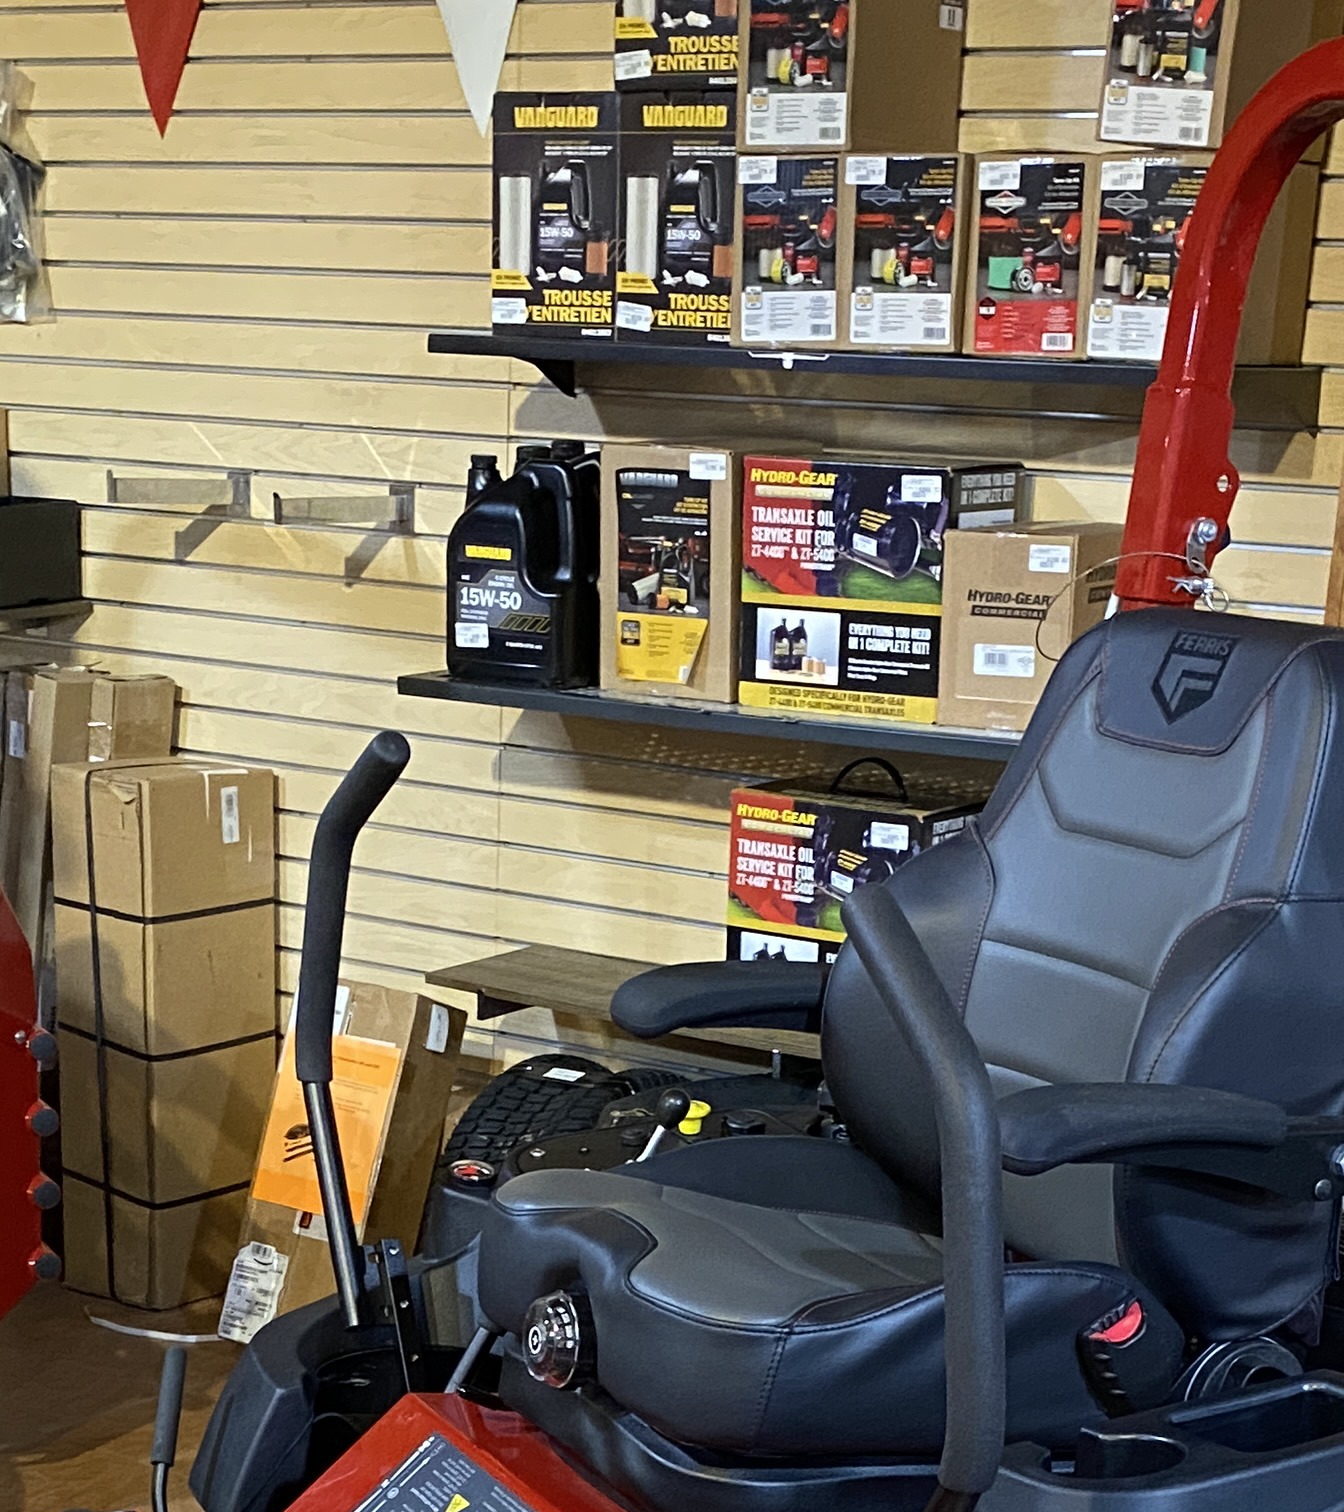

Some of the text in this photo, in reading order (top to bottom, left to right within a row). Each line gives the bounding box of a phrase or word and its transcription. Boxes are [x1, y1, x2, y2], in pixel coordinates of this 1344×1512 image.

[668, 35, 738, 54] TROUSSE
[651, 53, 738, 72] 'ENTRETIEN
[514, 106, 599, 128] VANGUARD
[643, 105, 728, 128] VANGUARD
[540, 226, 574, 238] 15W-50
[667, 229, 701, 241] 15W-50
[543, 289, 612, 306] TROUSSE
[668, 293, 731, 311] TROUSS
[526, 305, 612, 324] 'ENTRETIEN
[652, 310, 731, 329] 'ENTRETIE
[750, 468, 835, 486] HYDRO-GEAR
[751, 506, 836, 527] TRANSAXLE OIL
[751, 526, 835, 547] SERVICE KIT FOR
[460, 587, 522, 611] 15W-50
[967, 589, 1051, 606] HYDRO-GEAR
[974, 606, 1043, 619] COMMERCIAL
[865, 637, 911, 654] COMPLETE
[1176, 633, 1234, 656] FERRIS
[737, 803, 818, 826] HYDRO-GEAR
[737, 838, 815, 864] TRANSAXLE OIL
[737, 857, 814, 882] SERVICE KIT FOR
